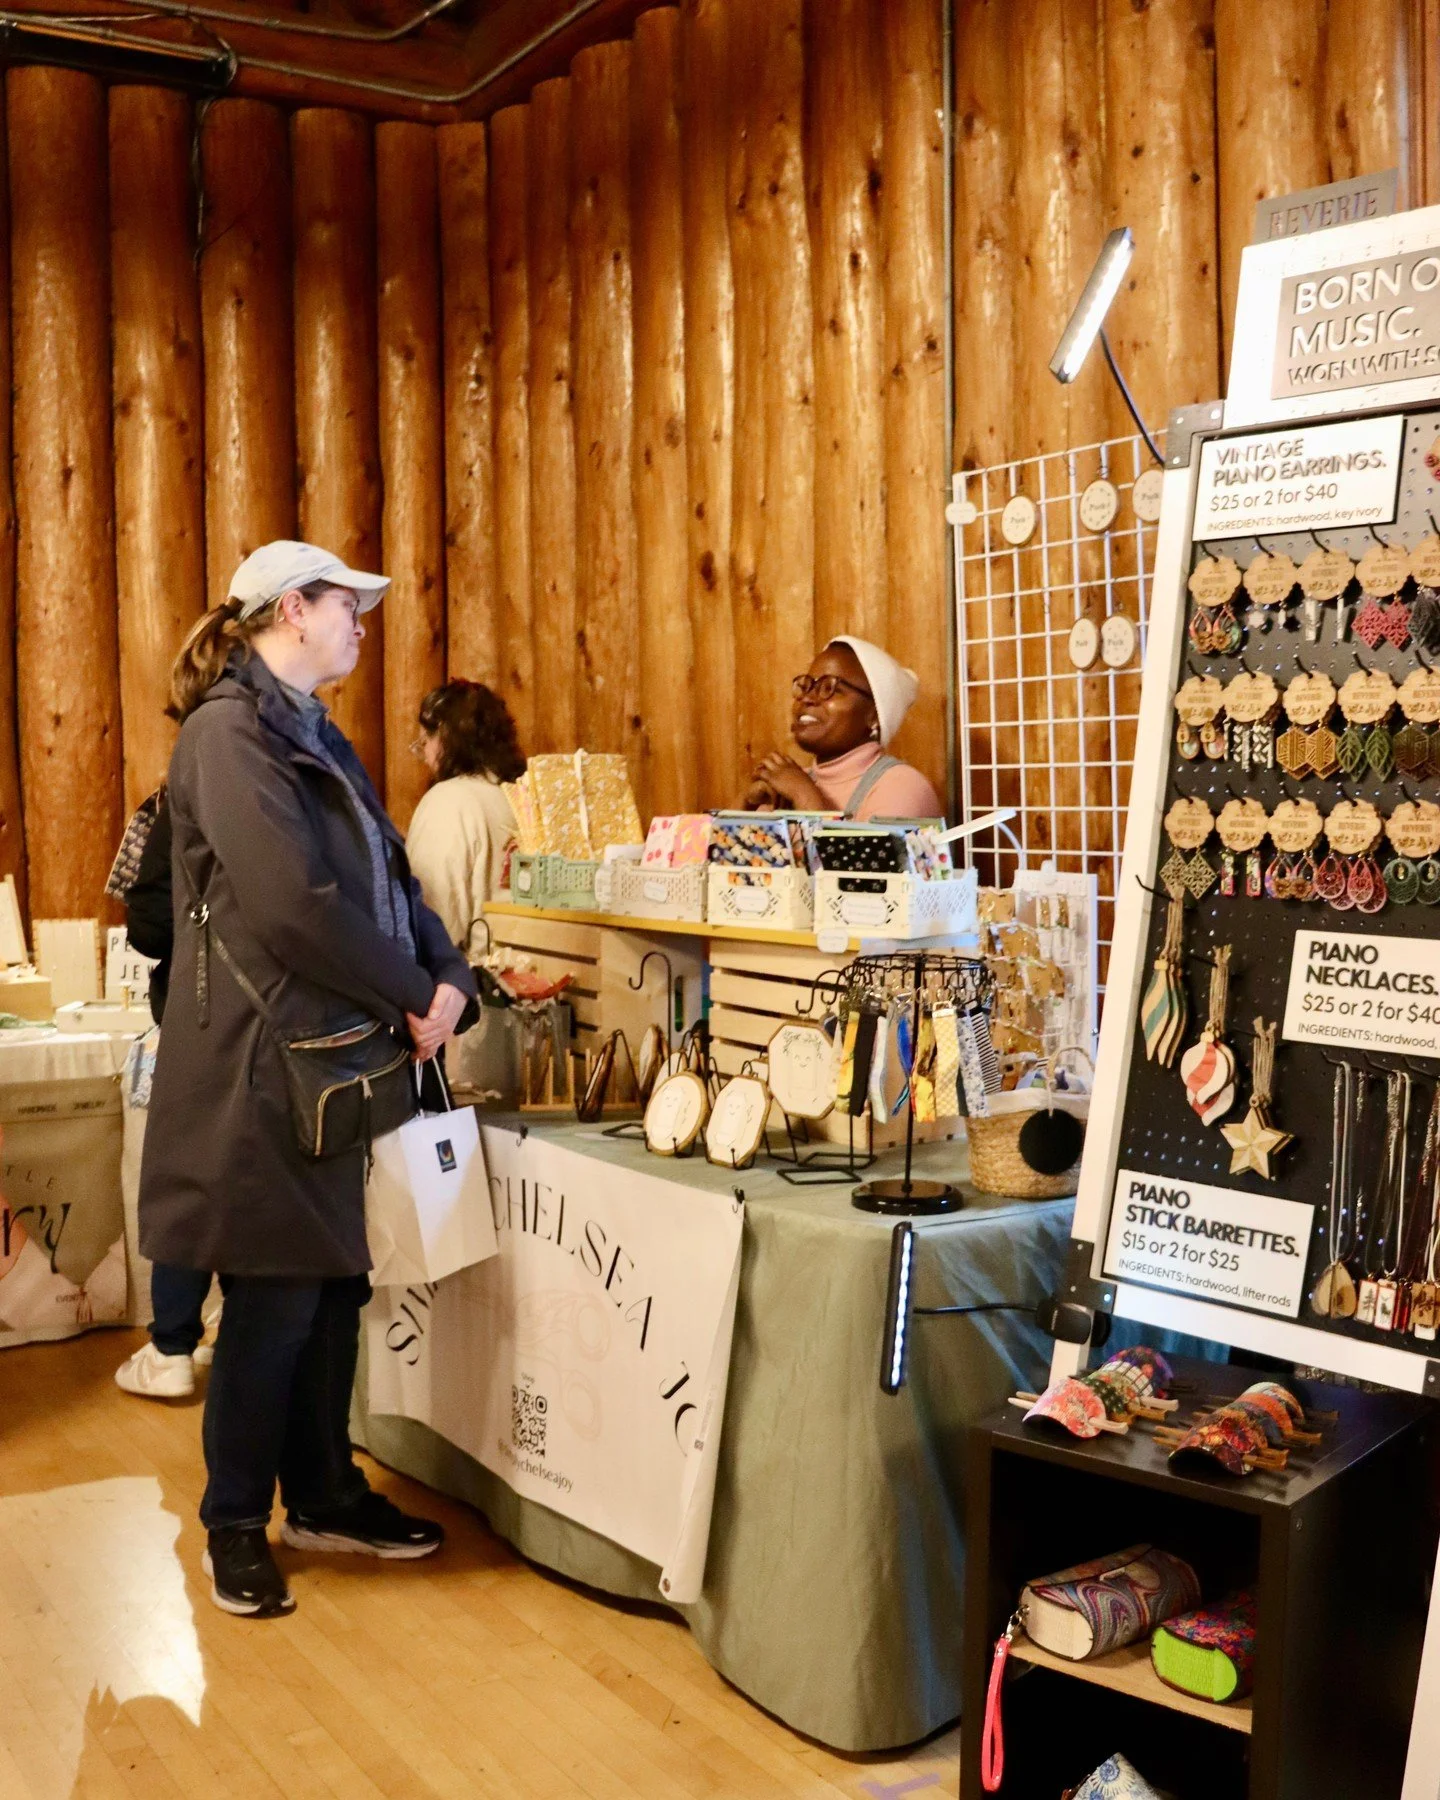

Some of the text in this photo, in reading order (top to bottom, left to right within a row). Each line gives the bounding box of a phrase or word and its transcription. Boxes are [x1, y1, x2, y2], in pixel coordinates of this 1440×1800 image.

[1294, 263, 1403, 315] BORN
[1289, 305, 1424, 358] MUSIC.
[1288, 345, 1440, 387] WORN WITH S
[1212, 450, 1387, 488] PIANO EARRINGS.
[1216, 438, 1304, 466] VINTAGE
[1210, 482, 1338, 512] $25 or 2 for $40
[1207, 505, 1383, 532] INGREDIENTS: hardwood, key ivory
[1309, 940, 1379, 964] PIANO
[1305, 964, 1439, 996] NECKLACES.
[1302, 992, 1335, 1013] $25
[1339, 1002, 1358, 1016] or
[1362, 1000, 1373, 1017] 2
[1377, 1001, 1403, 1020] for
[1298, 1022, 1438, 1050] INGREDIENTS: hardwood,
[1128, 1181, 1191, 1209] PIANO
[1126, 1204, 1300, 1257] STICK BARRETTES.
[488, 1176, 652, 1352] CHELSEA
[1122, 1231, 1240, 1272] $15 or 2 for $25
[1118, 1258, 1292, 1308] INGREDIENTS: hardwood, lifter rods
